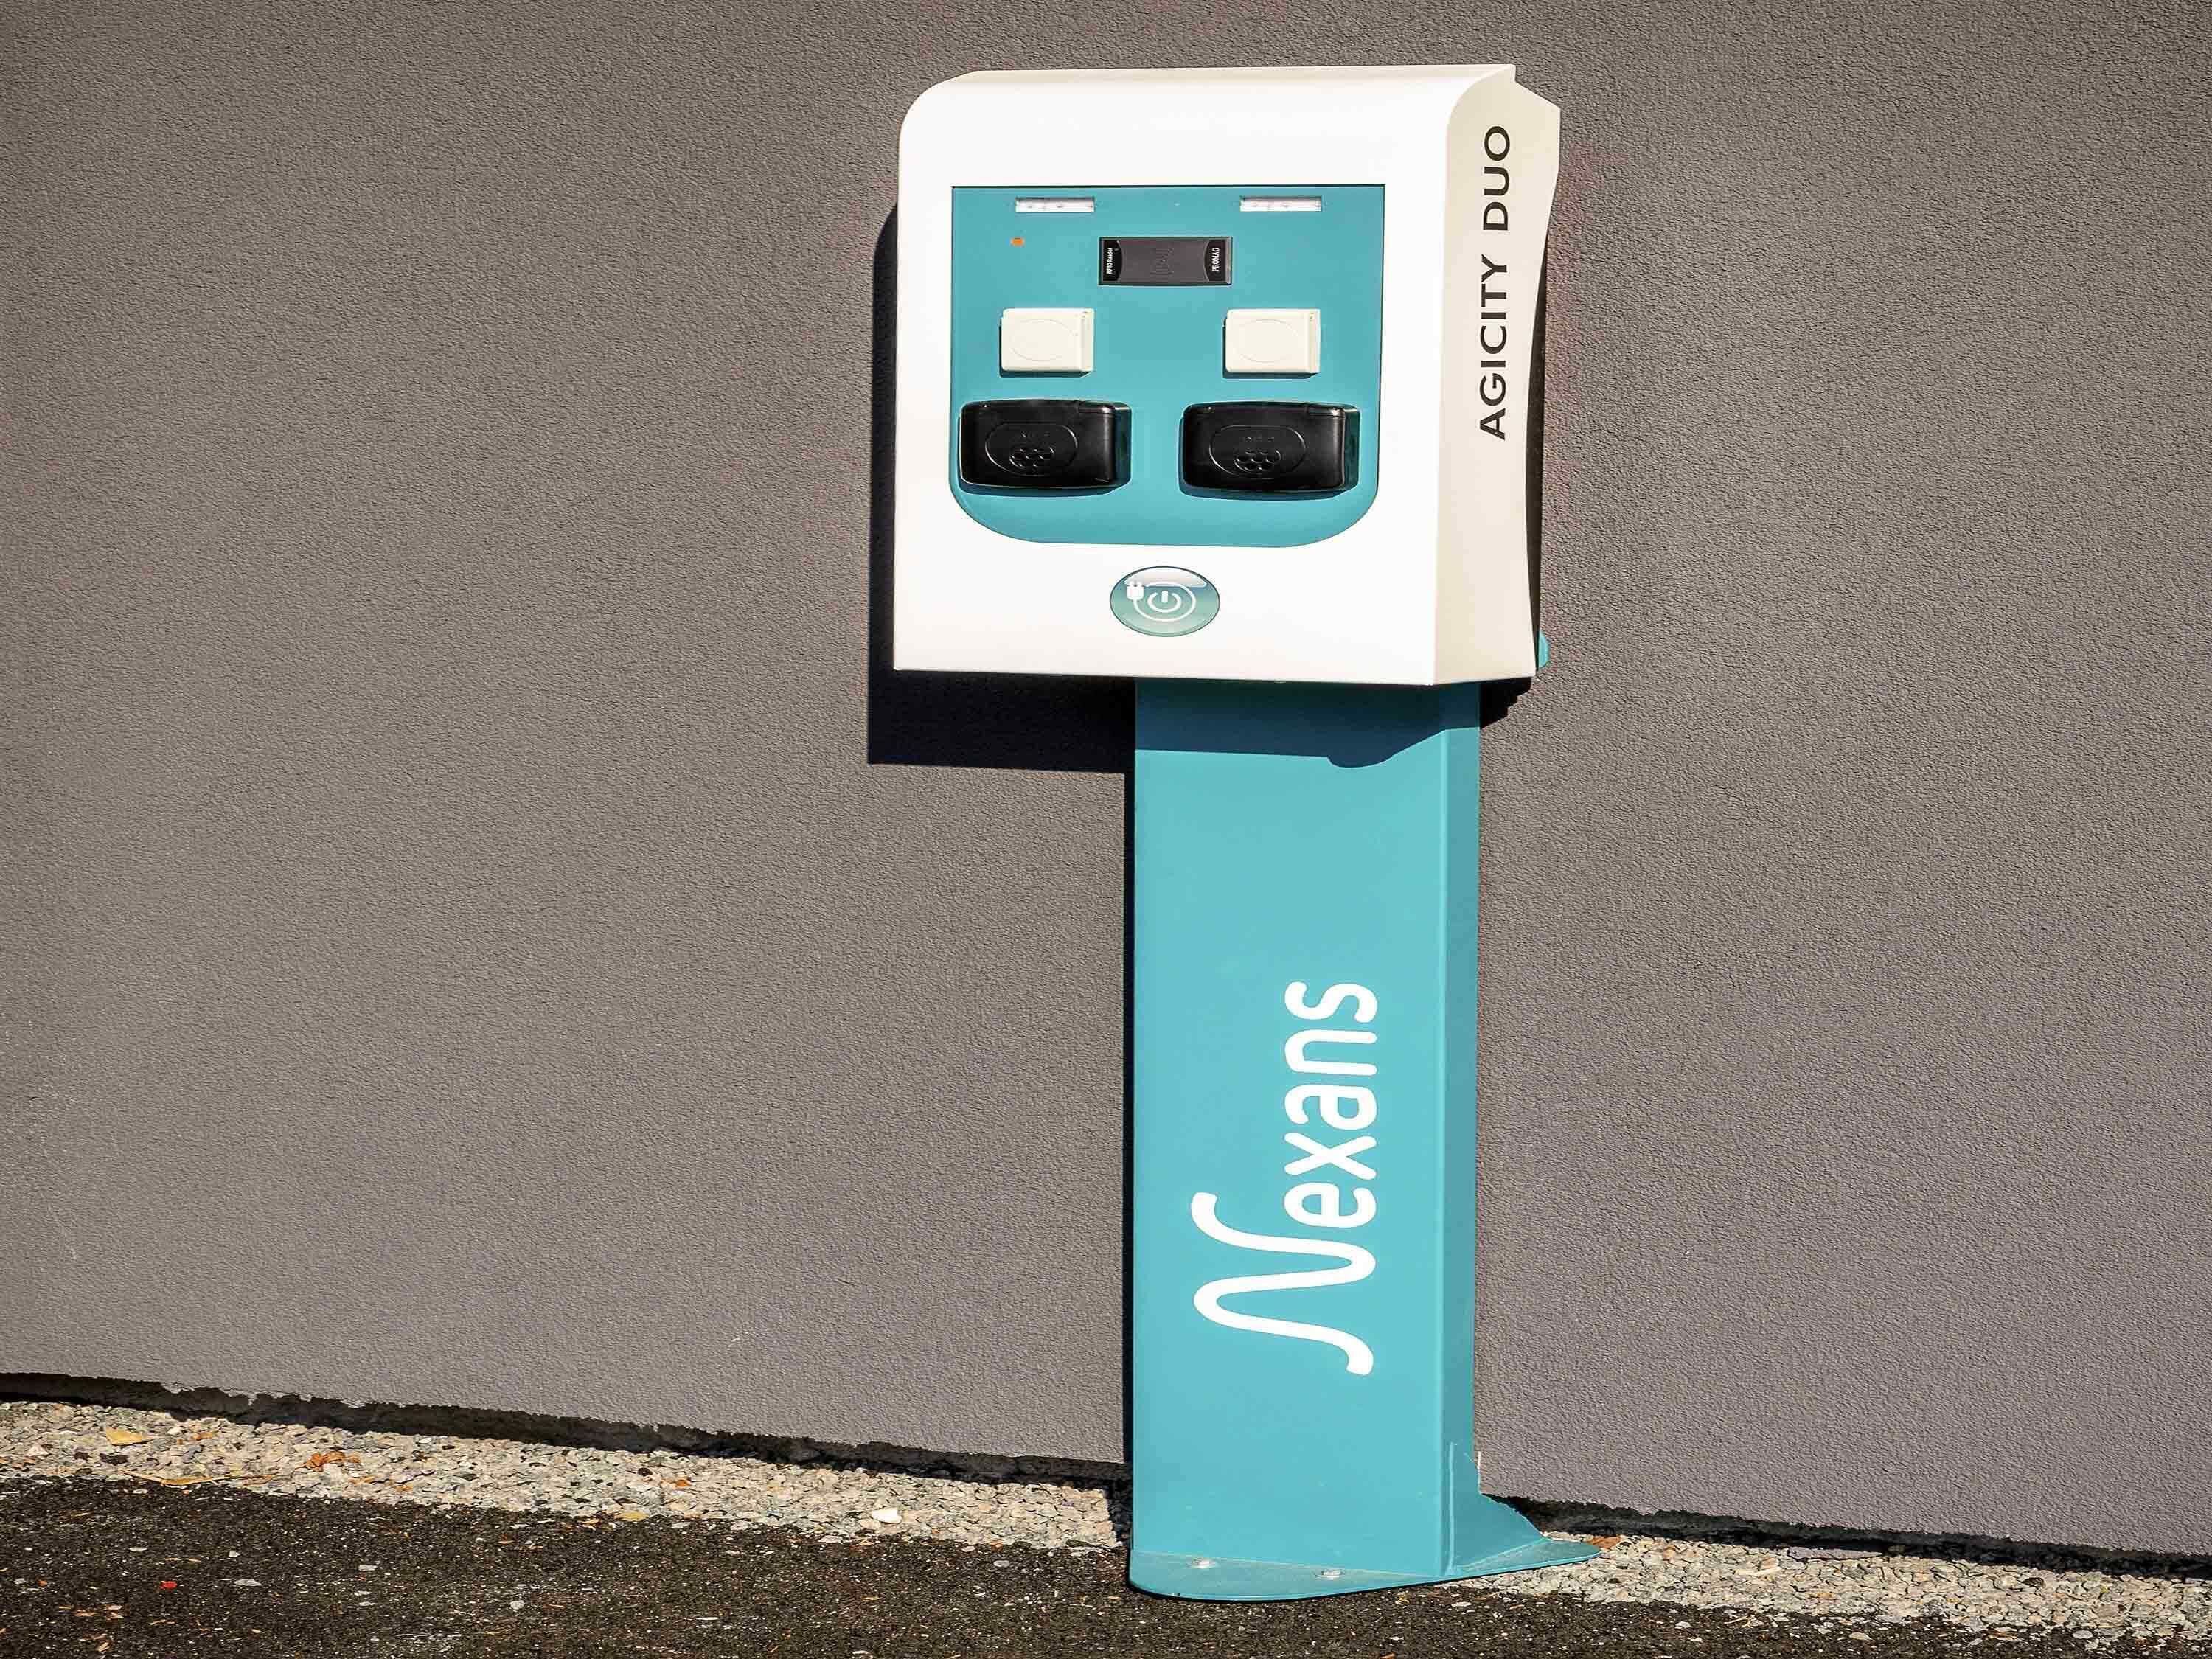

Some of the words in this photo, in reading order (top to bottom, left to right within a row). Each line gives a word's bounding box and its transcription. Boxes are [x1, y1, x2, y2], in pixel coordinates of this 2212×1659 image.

[1483, 125, 1510, 231] DUO
[1479, 254, 1508, 441] AGICITY
[1190, 981, 1378, 1376] Nexans
